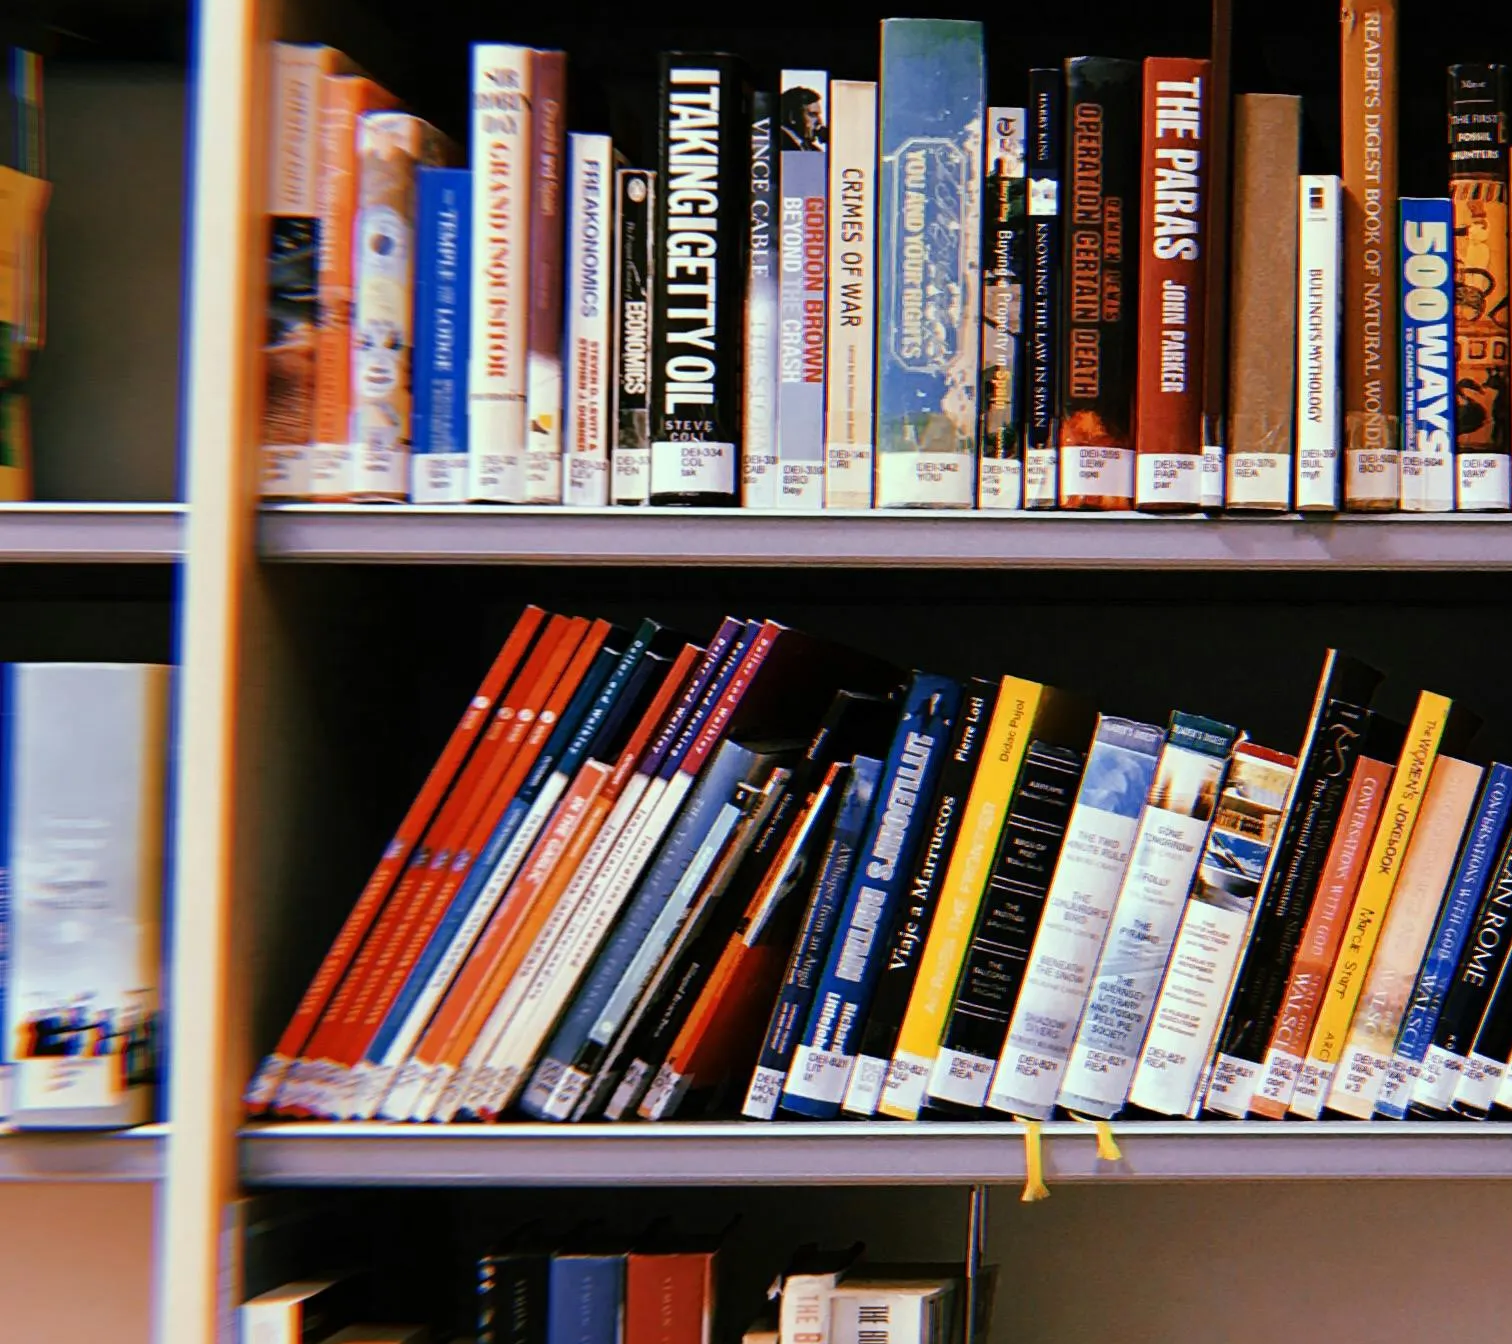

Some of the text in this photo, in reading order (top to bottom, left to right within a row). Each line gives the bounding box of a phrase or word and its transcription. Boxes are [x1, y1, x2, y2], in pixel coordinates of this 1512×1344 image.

[1363, 12, 1382, 108] READER'S
[750, 117, 770, 278] VINCE CABLE
[1152, 76, 1201, 262] THE PARAS
[1364, 114, 1381, 184] DIGEST
[1364, 188, 1380, 244] BOOK
[485, 142, 512, 378] GRAND INQUISITOR
[580, 159, 601, 318] FREAKONOMICS
[664, 86, 720, 415] TAKING GETTY OIL
[782, 197, 802, 383] BEYOND THE CRASH
[803, 197, 825, 383] GORDON BROWN
[840, 168, 863, 328] CRIMES OF WAR
[899, 149, 926, 359] YOU AND YOUR RIGHTS
[1070, 102, 1102, 398] OPERATION CERTAIN DEATH
[1364, 249, 1380, 276] OF
[434, 307, 458, 371] LODGE
[623, 300, 646, 394] ECONOMICS
[1034, 222, 1049, 428] KNOWING THE LAW IN SPAIN
[1160, 280, 1186, 393] JOHN PARKER
[1306, 268, 1323, 423] BULFINCH'S MYTHOLOGY
[1363, 282, 1381, 376] NATURAL
[1403, 219, 1448, 454] 500 WAYS
[731, 675, 750, 702] and
[834, 731, 935, 983] LITTLEJOHN'S BRITAIN
[1275, 778, 1328, 916] The Essential Frankenstein
[1461, 911, 1506, 988] ROME
[794, 1295, 820, 1325] THE
[857, 1304, 890, 1325] THE
